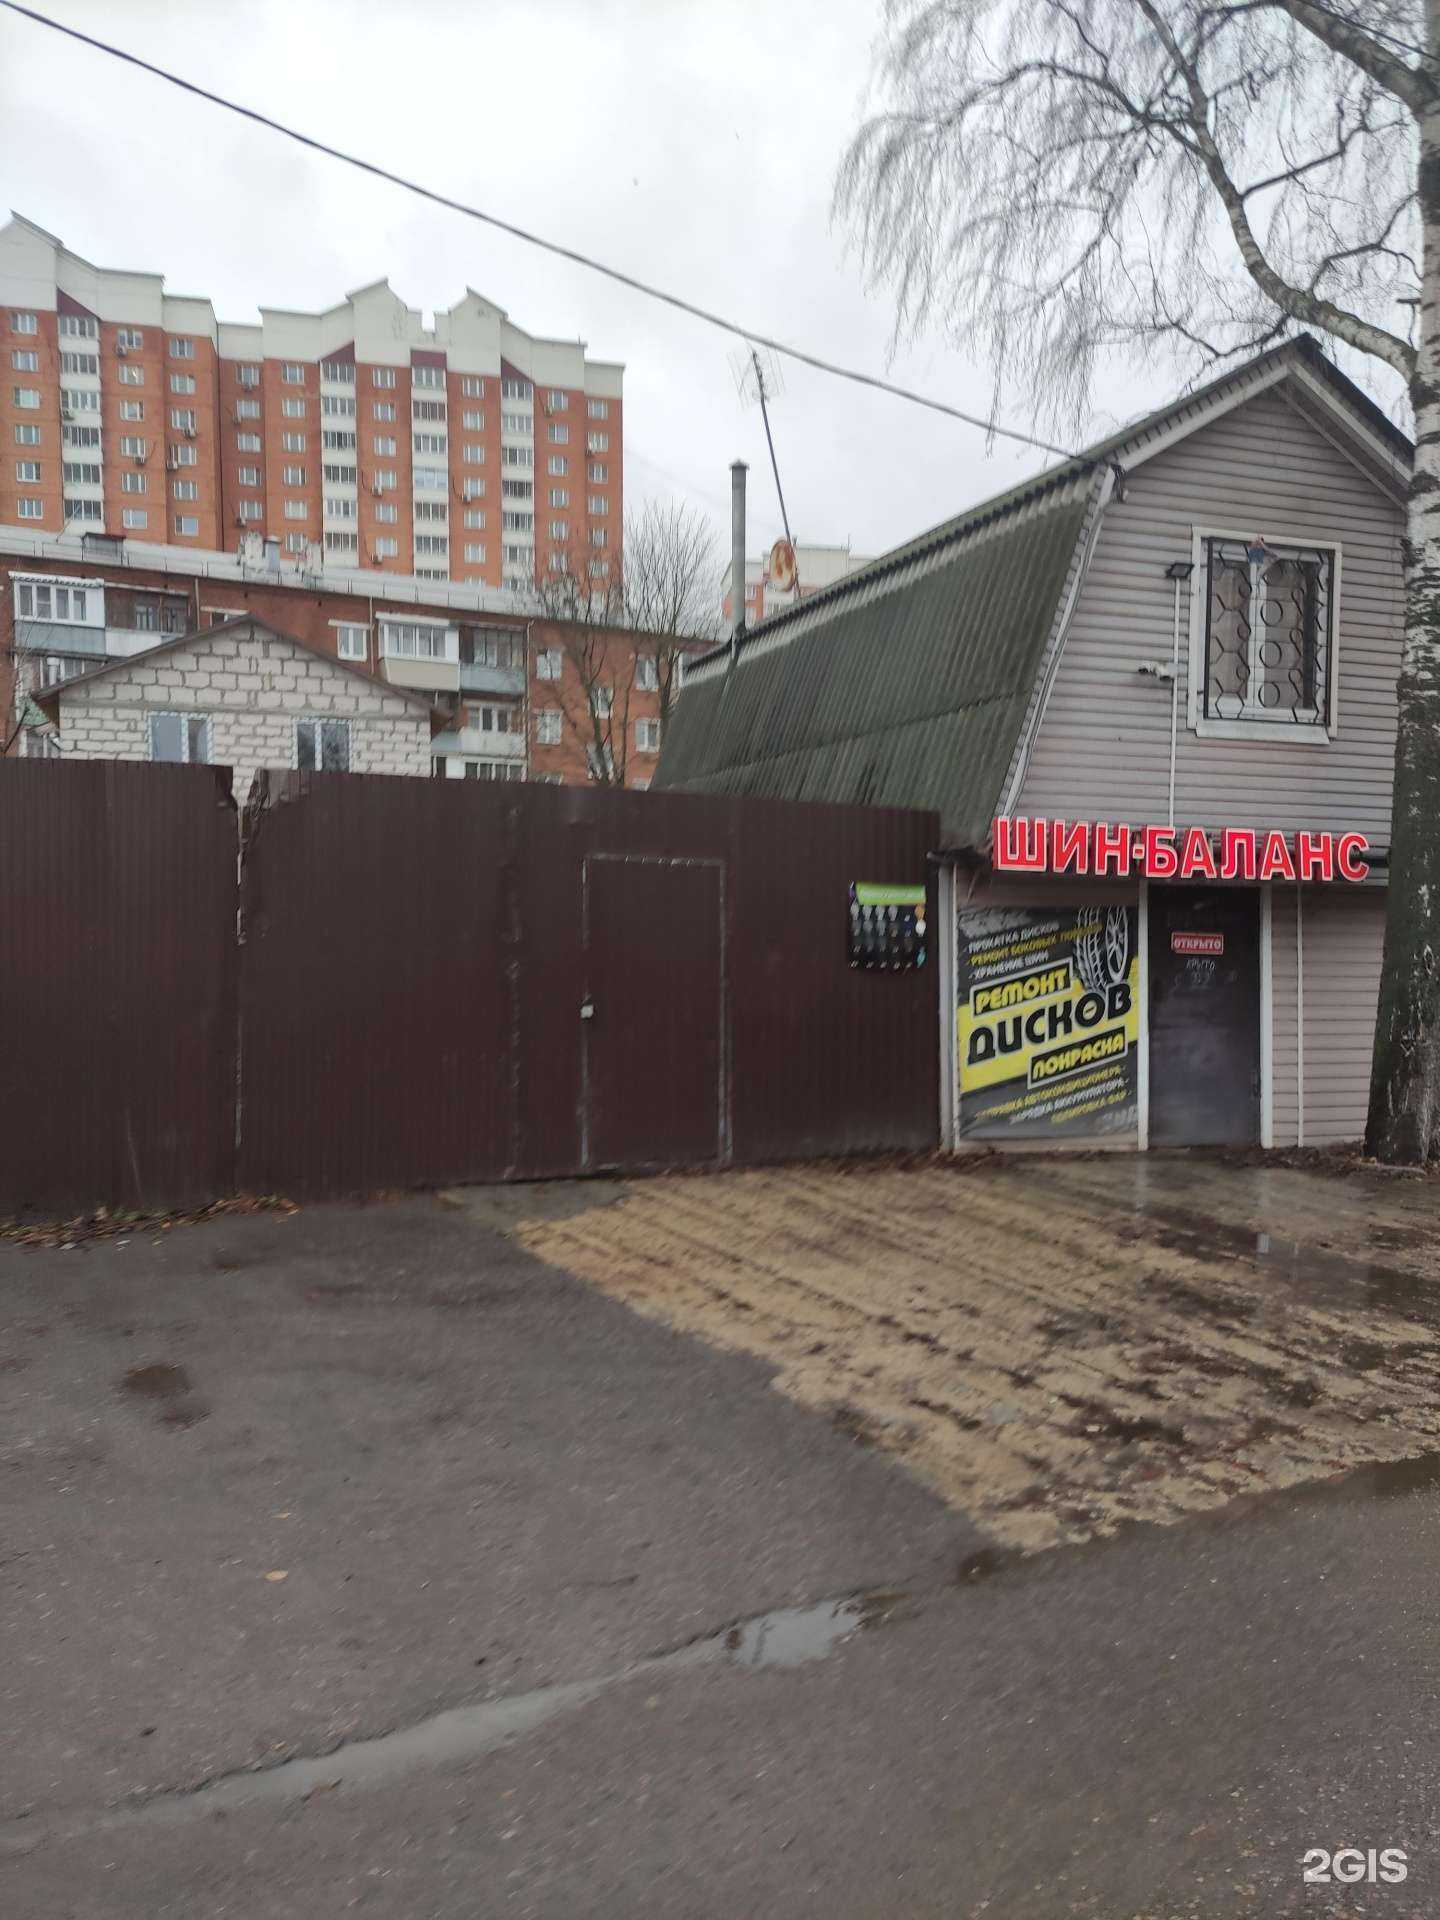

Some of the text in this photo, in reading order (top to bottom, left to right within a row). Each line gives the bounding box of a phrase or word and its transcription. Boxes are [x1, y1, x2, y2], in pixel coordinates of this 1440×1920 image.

[994, 816, 1370, 883] ШИН-БАЛАНС
[1174, 938, 1221, 950] ОТКРЫТО
[975, 968, 1068, 1014] РЕМОНТ
[967, 982, 1133, 1066] ДИСКОВ
[1031, 1030, 1125, 1080] ПОКРАСКА
